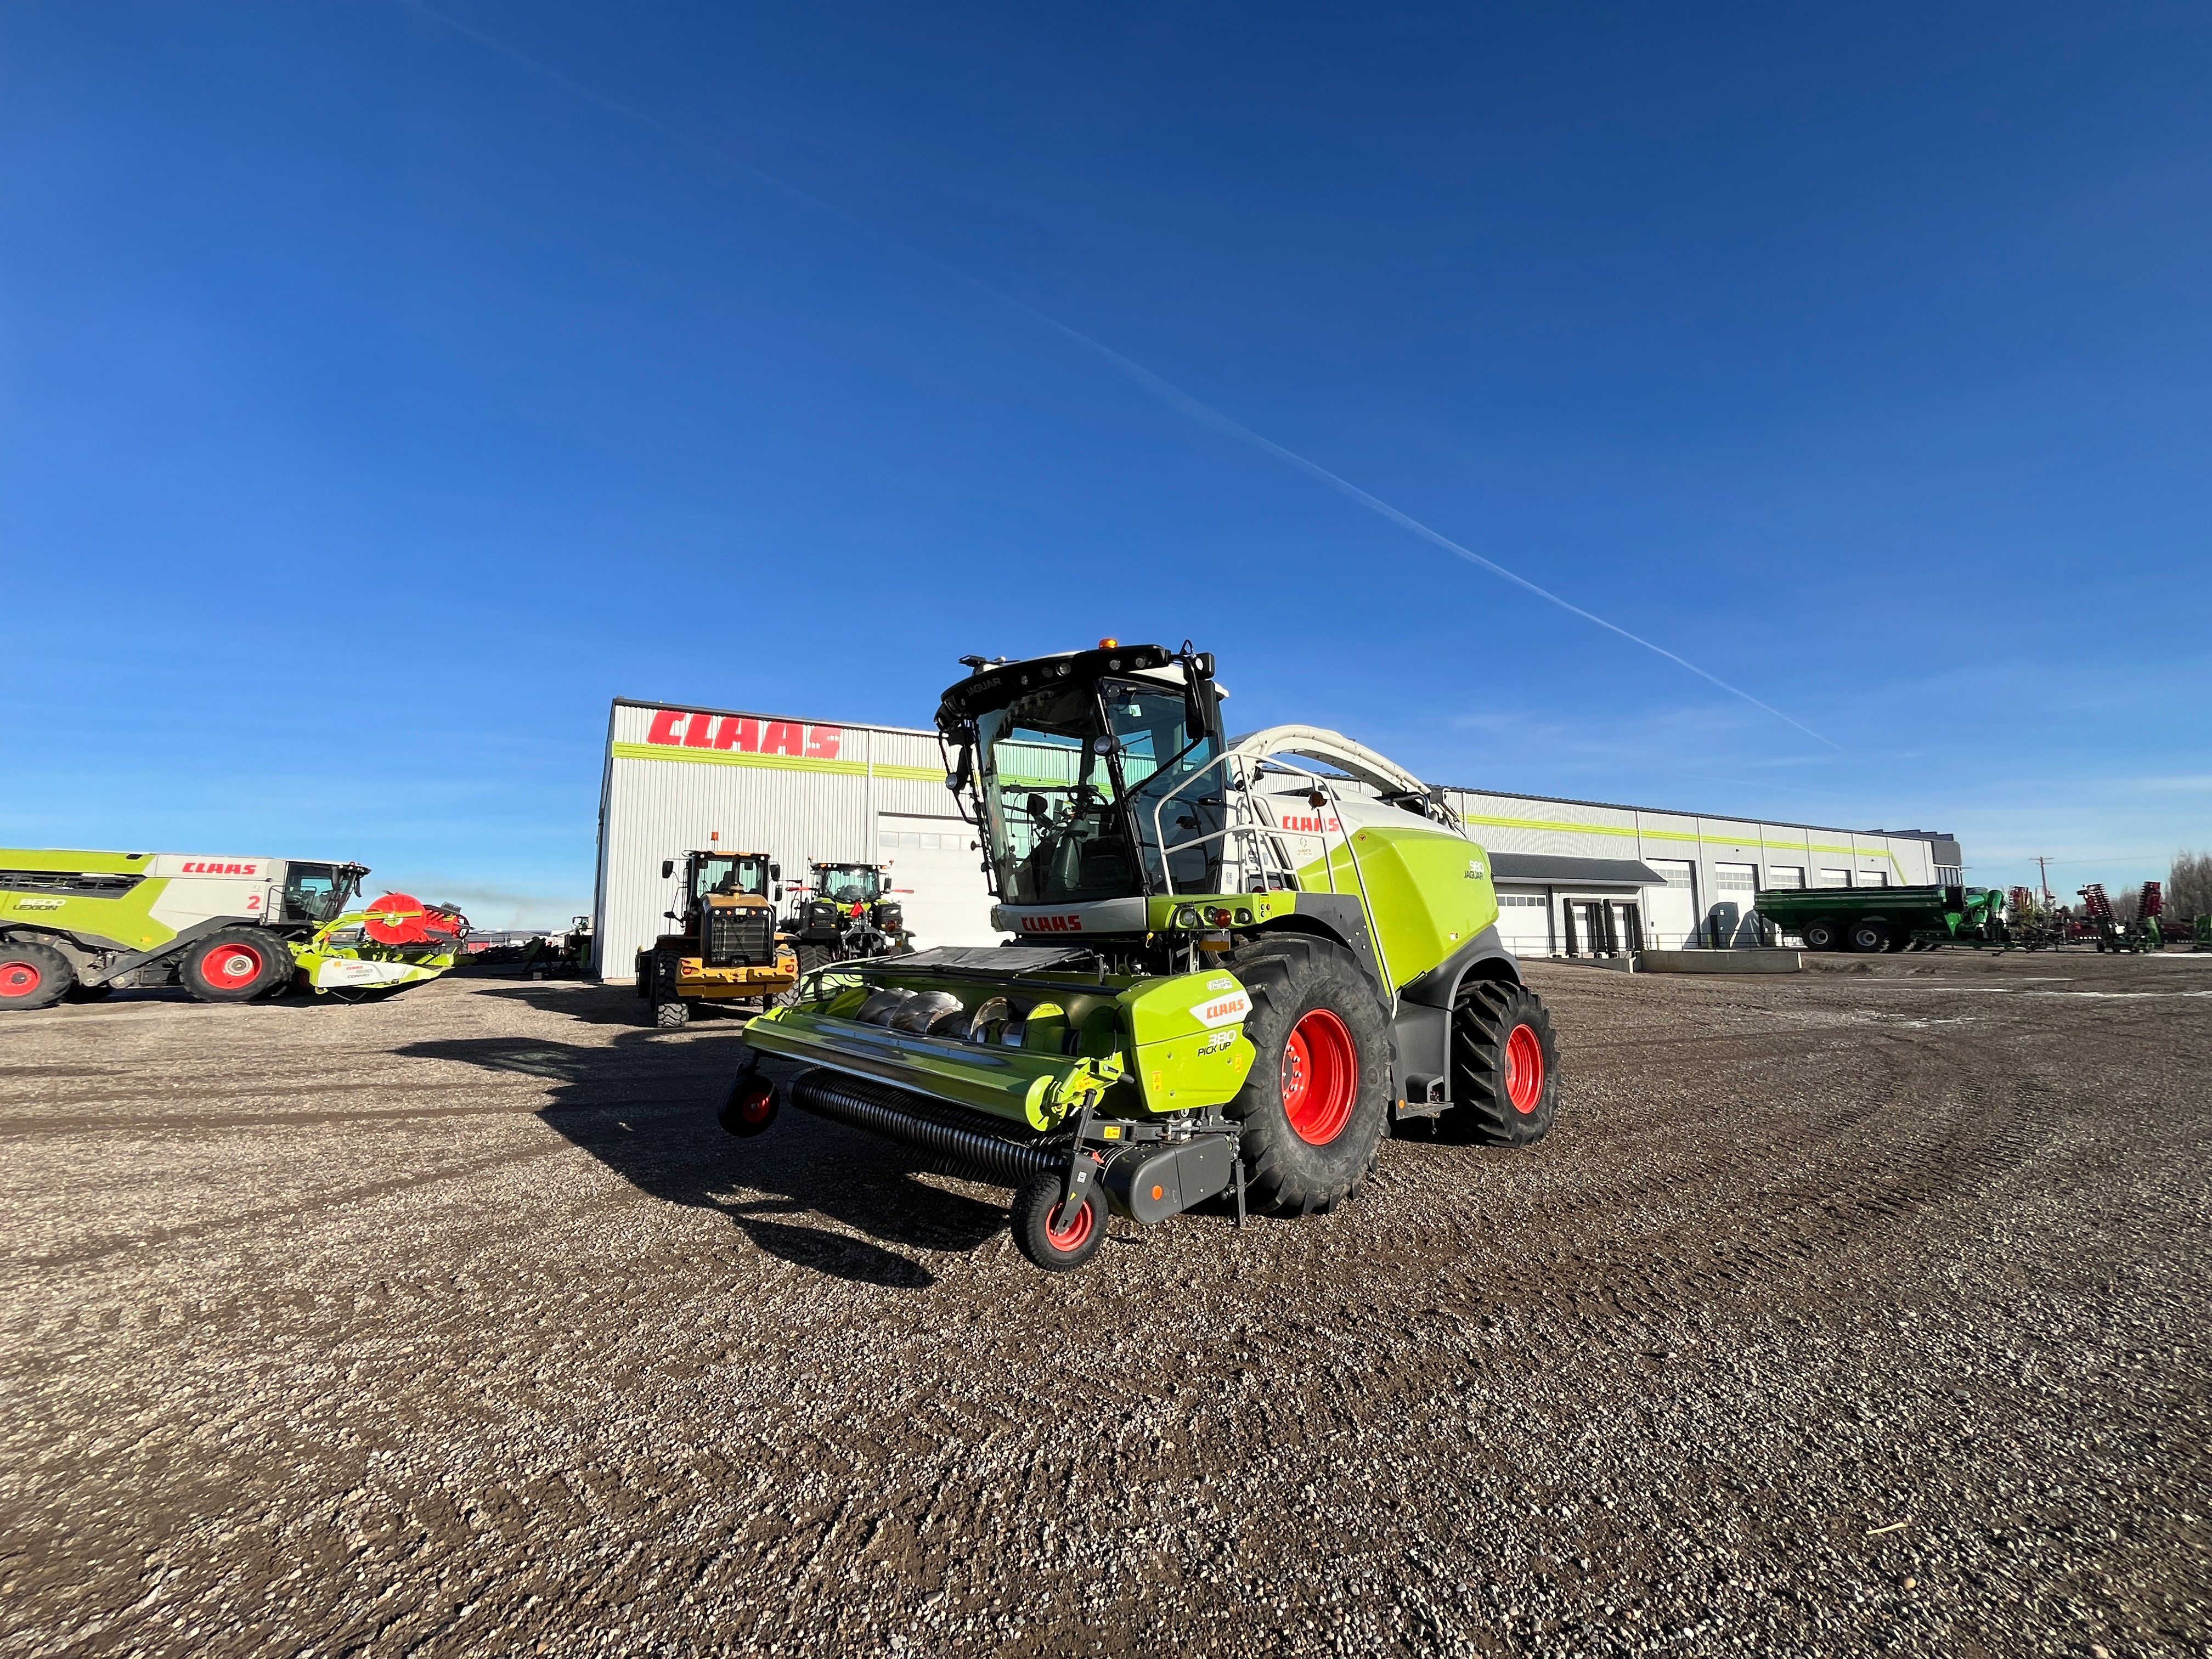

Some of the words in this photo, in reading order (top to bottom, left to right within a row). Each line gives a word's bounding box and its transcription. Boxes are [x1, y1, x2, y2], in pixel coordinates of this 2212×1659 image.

[966, 678, 1002, 696] JAGUAR
[647, 710, 842, 759] CLAAS
[182, 862, 257, 874] CLAAS
[1469, 860, 1485, 872] 980
[1464, 870, 1483, 880] JAGUAR
[247, 895, 261, 909] 2
[1021, 915, 1082, 932] CLAAS
[1206, 999, 1244, 1019] CLAAS
[1208, 1030, 1237, 1047] 380
[1198, 1045, 1217, 1057] PICK
[1220, 1042, 1231, 1051] UP
